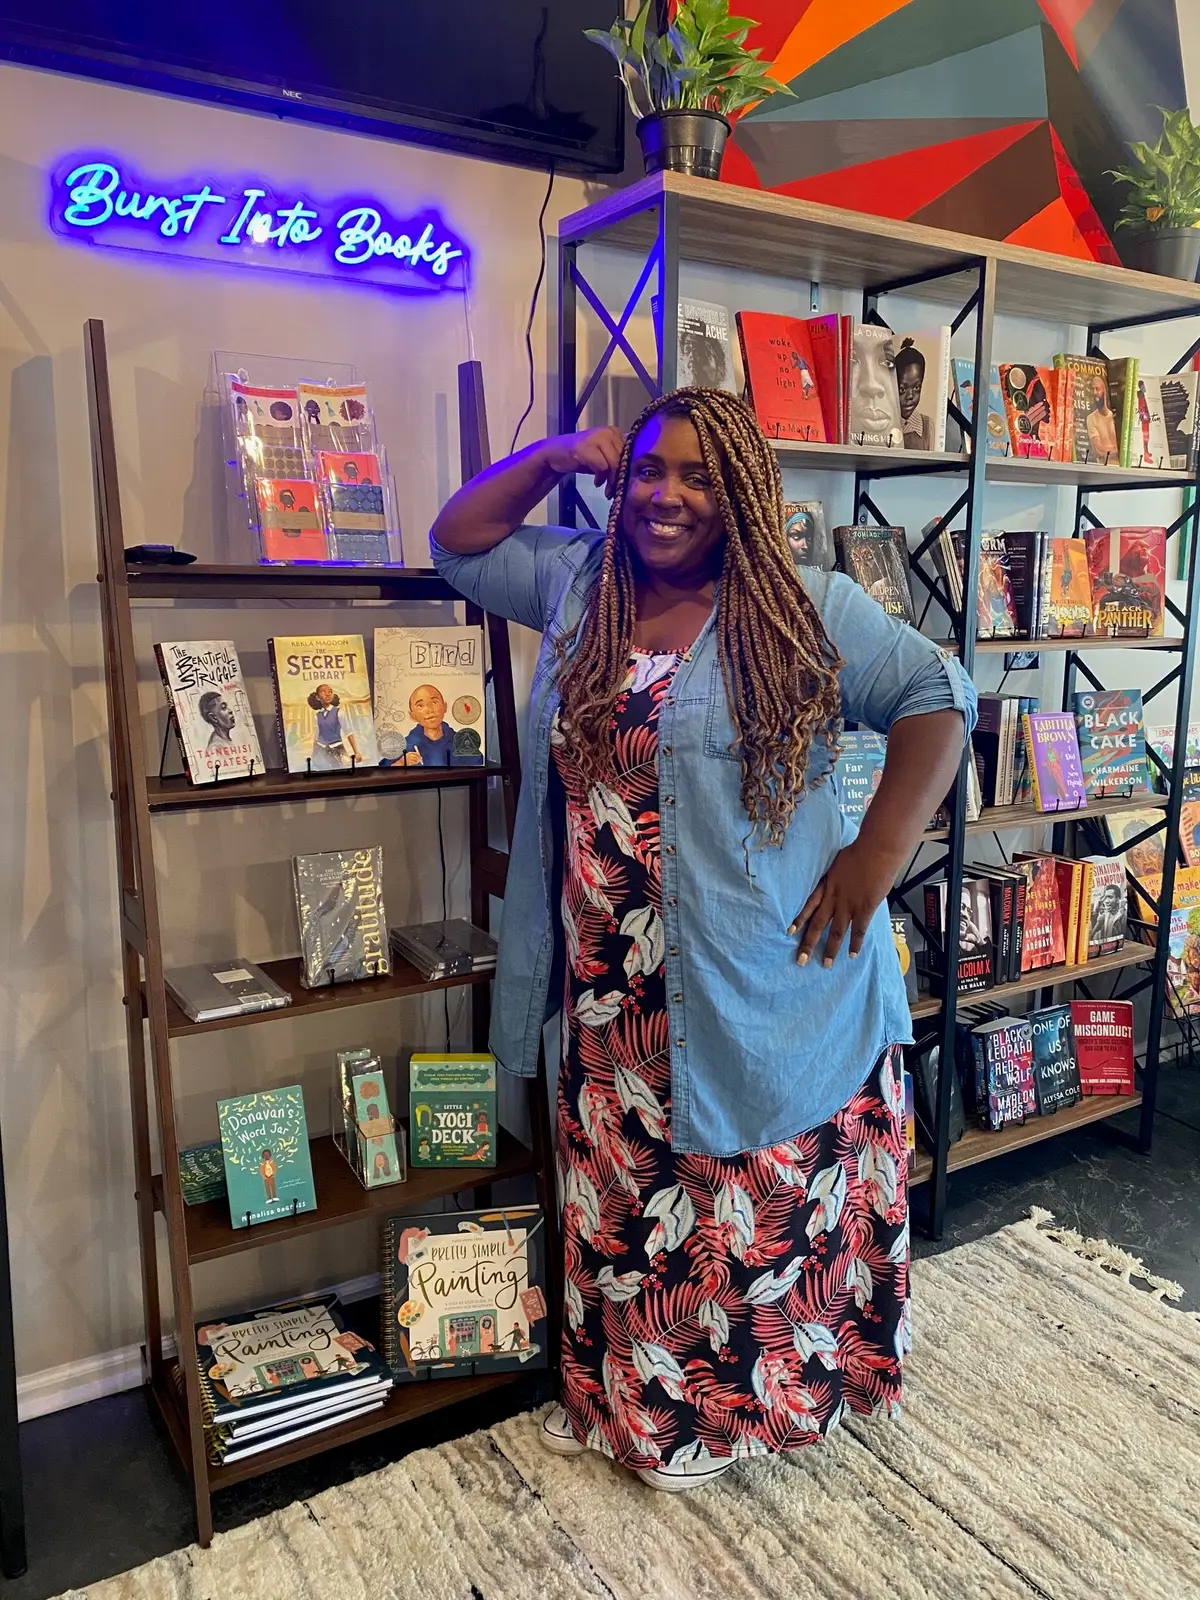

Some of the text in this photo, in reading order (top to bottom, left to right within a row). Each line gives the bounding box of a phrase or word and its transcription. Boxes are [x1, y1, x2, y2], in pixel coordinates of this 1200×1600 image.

[282, 89, 302, 100] NEC
[64, 162, 464, 276] Burst Into Books
[705, 325, 729, 341] ACHE
[865, 328, 890, 340] DAVIS
[769, 337, 792, 348] woke
[777, 352, 788, 362] up
[779, 366, 790, 375] no
[1067, 362, 1108, 376] COMMON
[776, 377, 796, 389] light
[1075, 390, 1085, 398] WE
[766, 421, 820, 438] Lela Mottey
[851, 432, 879, 443] INDING
[981, 537, 1007, 555] ORM
[1097, 611, 1153, 629] PANTHER
[169, 645, 188, 659] THE
[414, 641, 473, 667] Bird
[175, 648, 235, 679] BEAUTIFUL
[287, 652, 357, 676] SECRET
[174, 664, 238, 692] STRUGGLE
[302, 670, 347, 681] LIBRARY
[1032, 719, 1075, 732] TABITHA
[1084, 711, 1139, 728] BLACK
[1037, 731, 1075, 744] BROWN
[1156, 728, 1175, 737] LEBRO
[1090, 734, 1137, 749] CAKE
[196, 744, 253, 759] TA-NEHISI
[206, 757, 248, 770] COATES
[845, 763, 864, 773] Far
[1091, 764, 1139, 775] CHARMAINE
[842, 776, 868, 786] from
[1090, 776, 1143, 786] WILKERSON
[847, 788, 864, 799] the
[839, 803, 864, 813] Tree
[1093, 862, 1121, 877] SINATION
[1096, 874, 1125, 886] HAMPTON
[1003, 887, 1012, 920] MALCOLM
[1016, 885, 1025, 917] MALCOLM
[350, 847, 389, 976] gratitude
[957, 962, 984, 978] LCOLM
[985, 958, 991, 973] X
[969, 981, 986, 989] HALEY
[1090, 1010, 1116, 1023] GAME
[1033, 1015, 1071, 1036] ONE OF
[1074, 1024, 1132, 1038] MISCONDUCT
[992, 1026, 1024, 1048] BLACK
[988, 1039, 1033, 1062] LEOPARD
[1048, 1040, 1062, 1054] US
[995, 1059, 1014, 1076] RED
[1040, 1057, 1076, 1079] KNOWS
[1006, 1067, 1032, 1086] WOLF
[997, 1088, 1035, 1111] MARLON
[1043, 1085, 1080, 1105] ALYSSA COLE
[227, 1104, 295, 1132] Donavan's
[434, 1112, 474, 1128] YOGI
[992, 1104, 1024, 1126] JAMES
[237, 1122, 290, 1145] Word Jar
[431, 1129, 476, 1144] DECK
[241, 1201, 307, 1222] Mnalisa DeGrss
[431, 1242, 508, 1261] PRETTY SIMPLE
[410, 1256, 530, 1309] Painting
[231, 1315, 310, 1339] PRETTY SIMPLE
[214, 1318, 337, 1365] Painting
